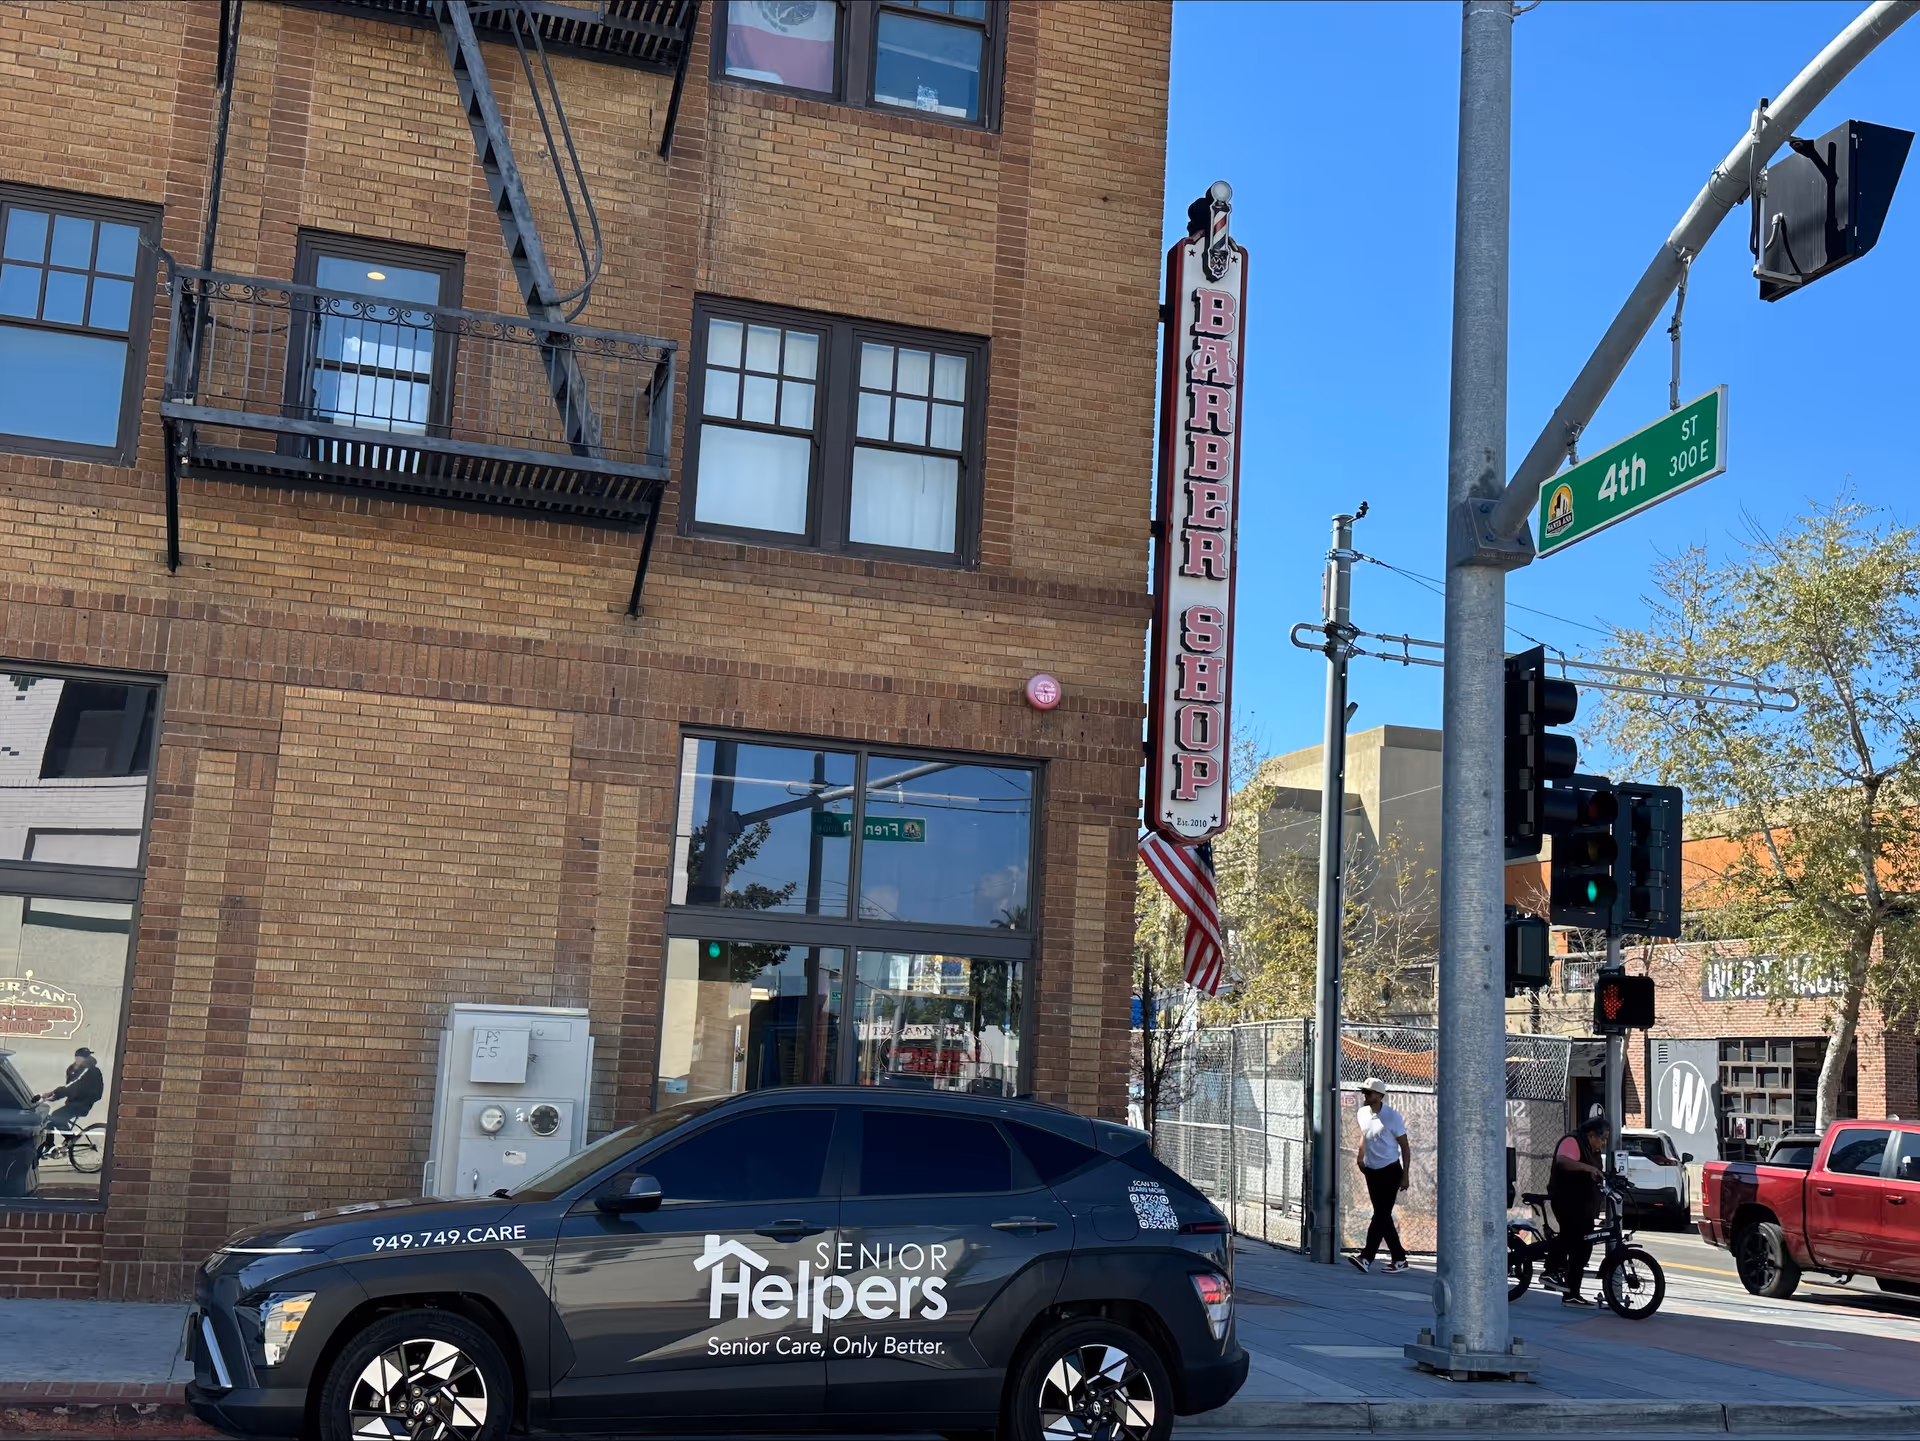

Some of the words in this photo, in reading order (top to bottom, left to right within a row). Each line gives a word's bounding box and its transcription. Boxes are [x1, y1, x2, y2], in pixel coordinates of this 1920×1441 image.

[1180, 288, 1236, 579] BARBER
[1681, 414, 1698, 441] ST
[1598, 452, 1646, 502] 4th
[1172, 605, 1224, 801] SHOP
[372, 1224, 527, 1251] 949.749.CARE
[815, 1241, 948, 1271] SENIOR
[709, 1260, 948, 1334] Helpers
[707, 1336, 769, 1356] Senior
[776, 1336, 826, 1357] Care,
[833, 1335, 878, 1358] Only
[884, 1336, 946, 1355] Better.
